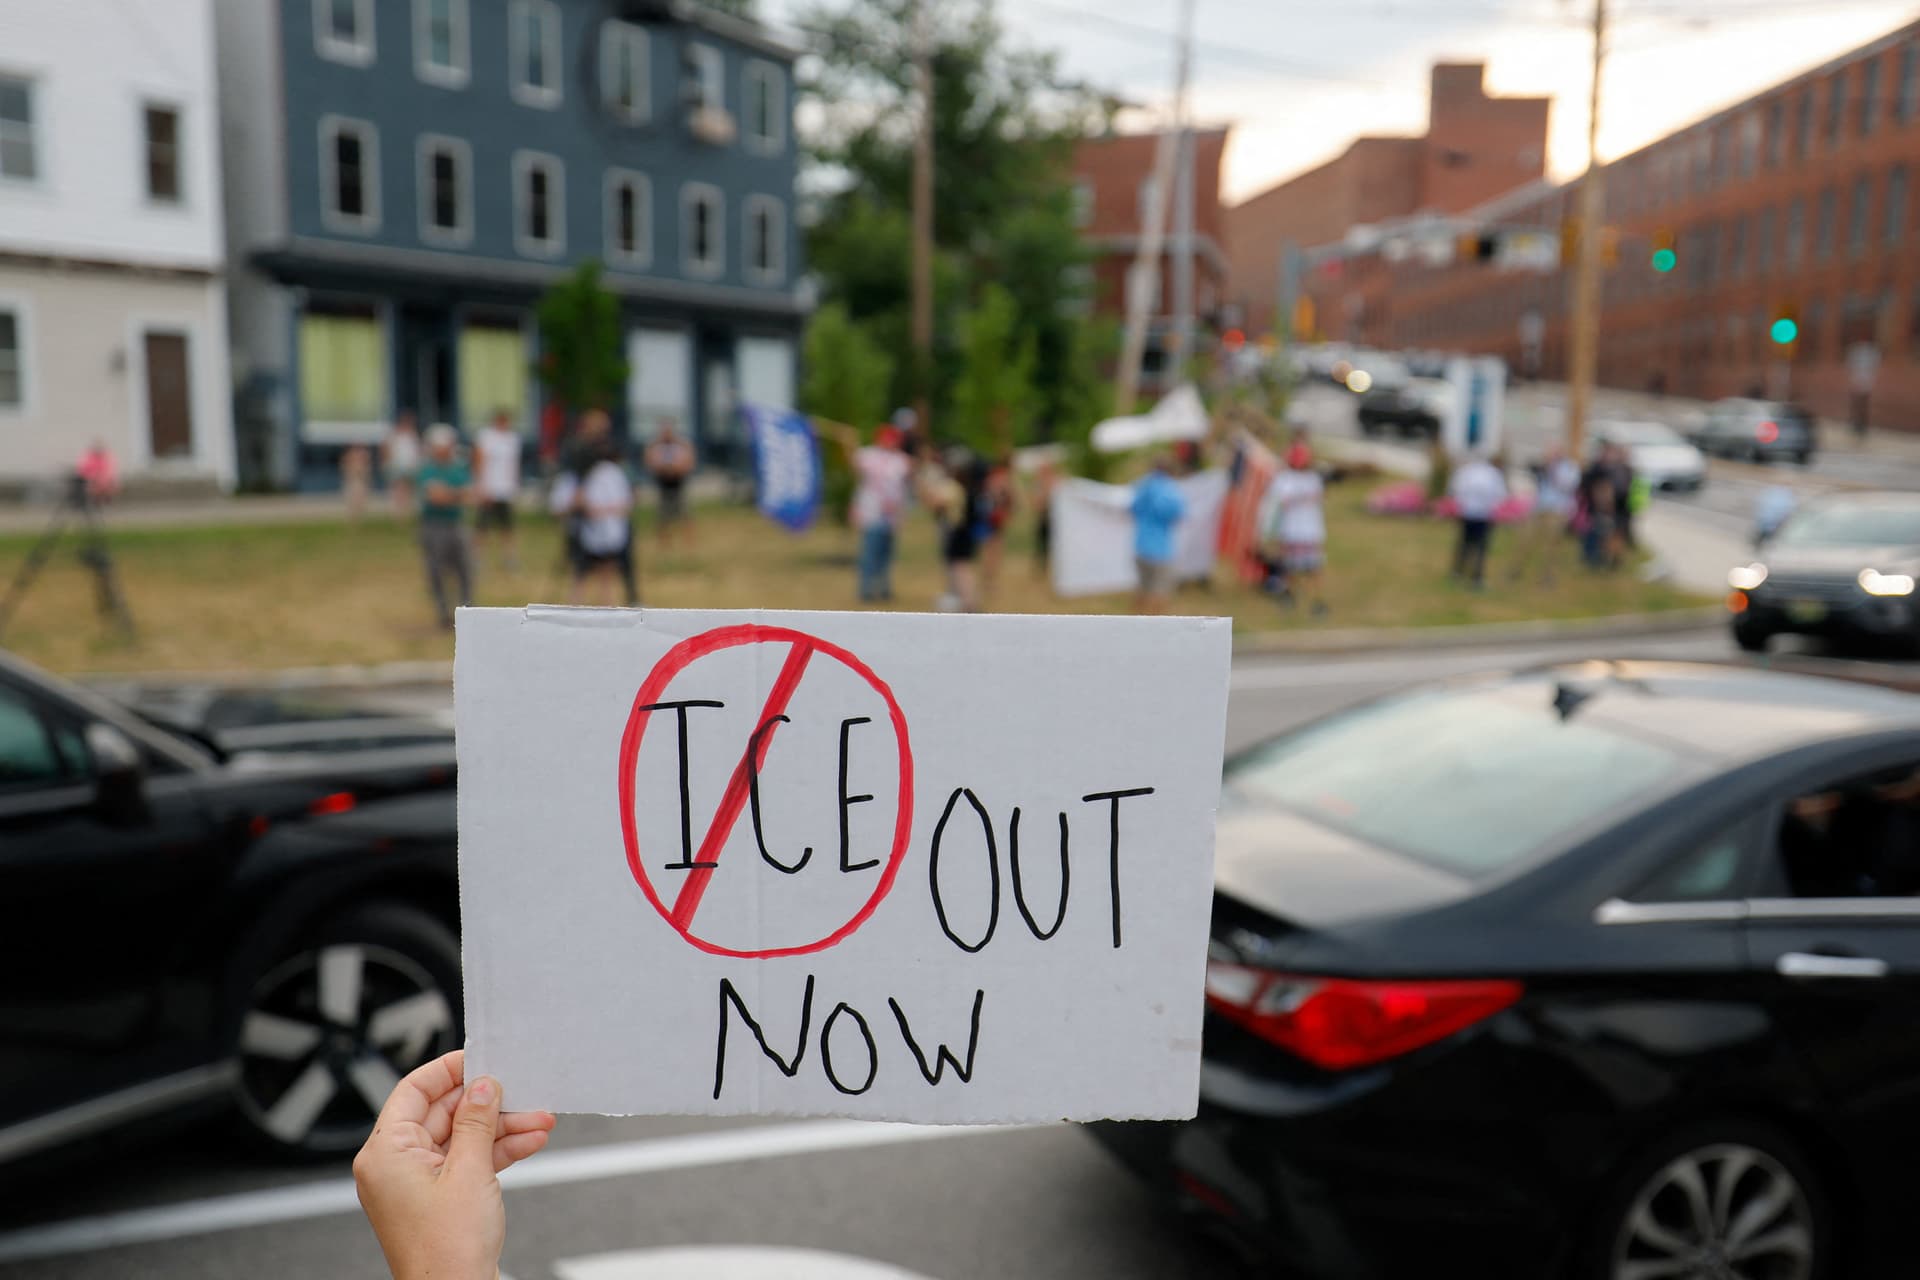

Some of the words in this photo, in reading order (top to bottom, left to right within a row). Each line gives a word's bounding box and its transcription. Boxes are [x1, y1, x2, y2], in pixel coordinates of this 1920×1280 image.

[639, 699, 880, 875] ICE
[929, 787, 1155, 954] OUT
[713, 974, 985, 1100] NOW
